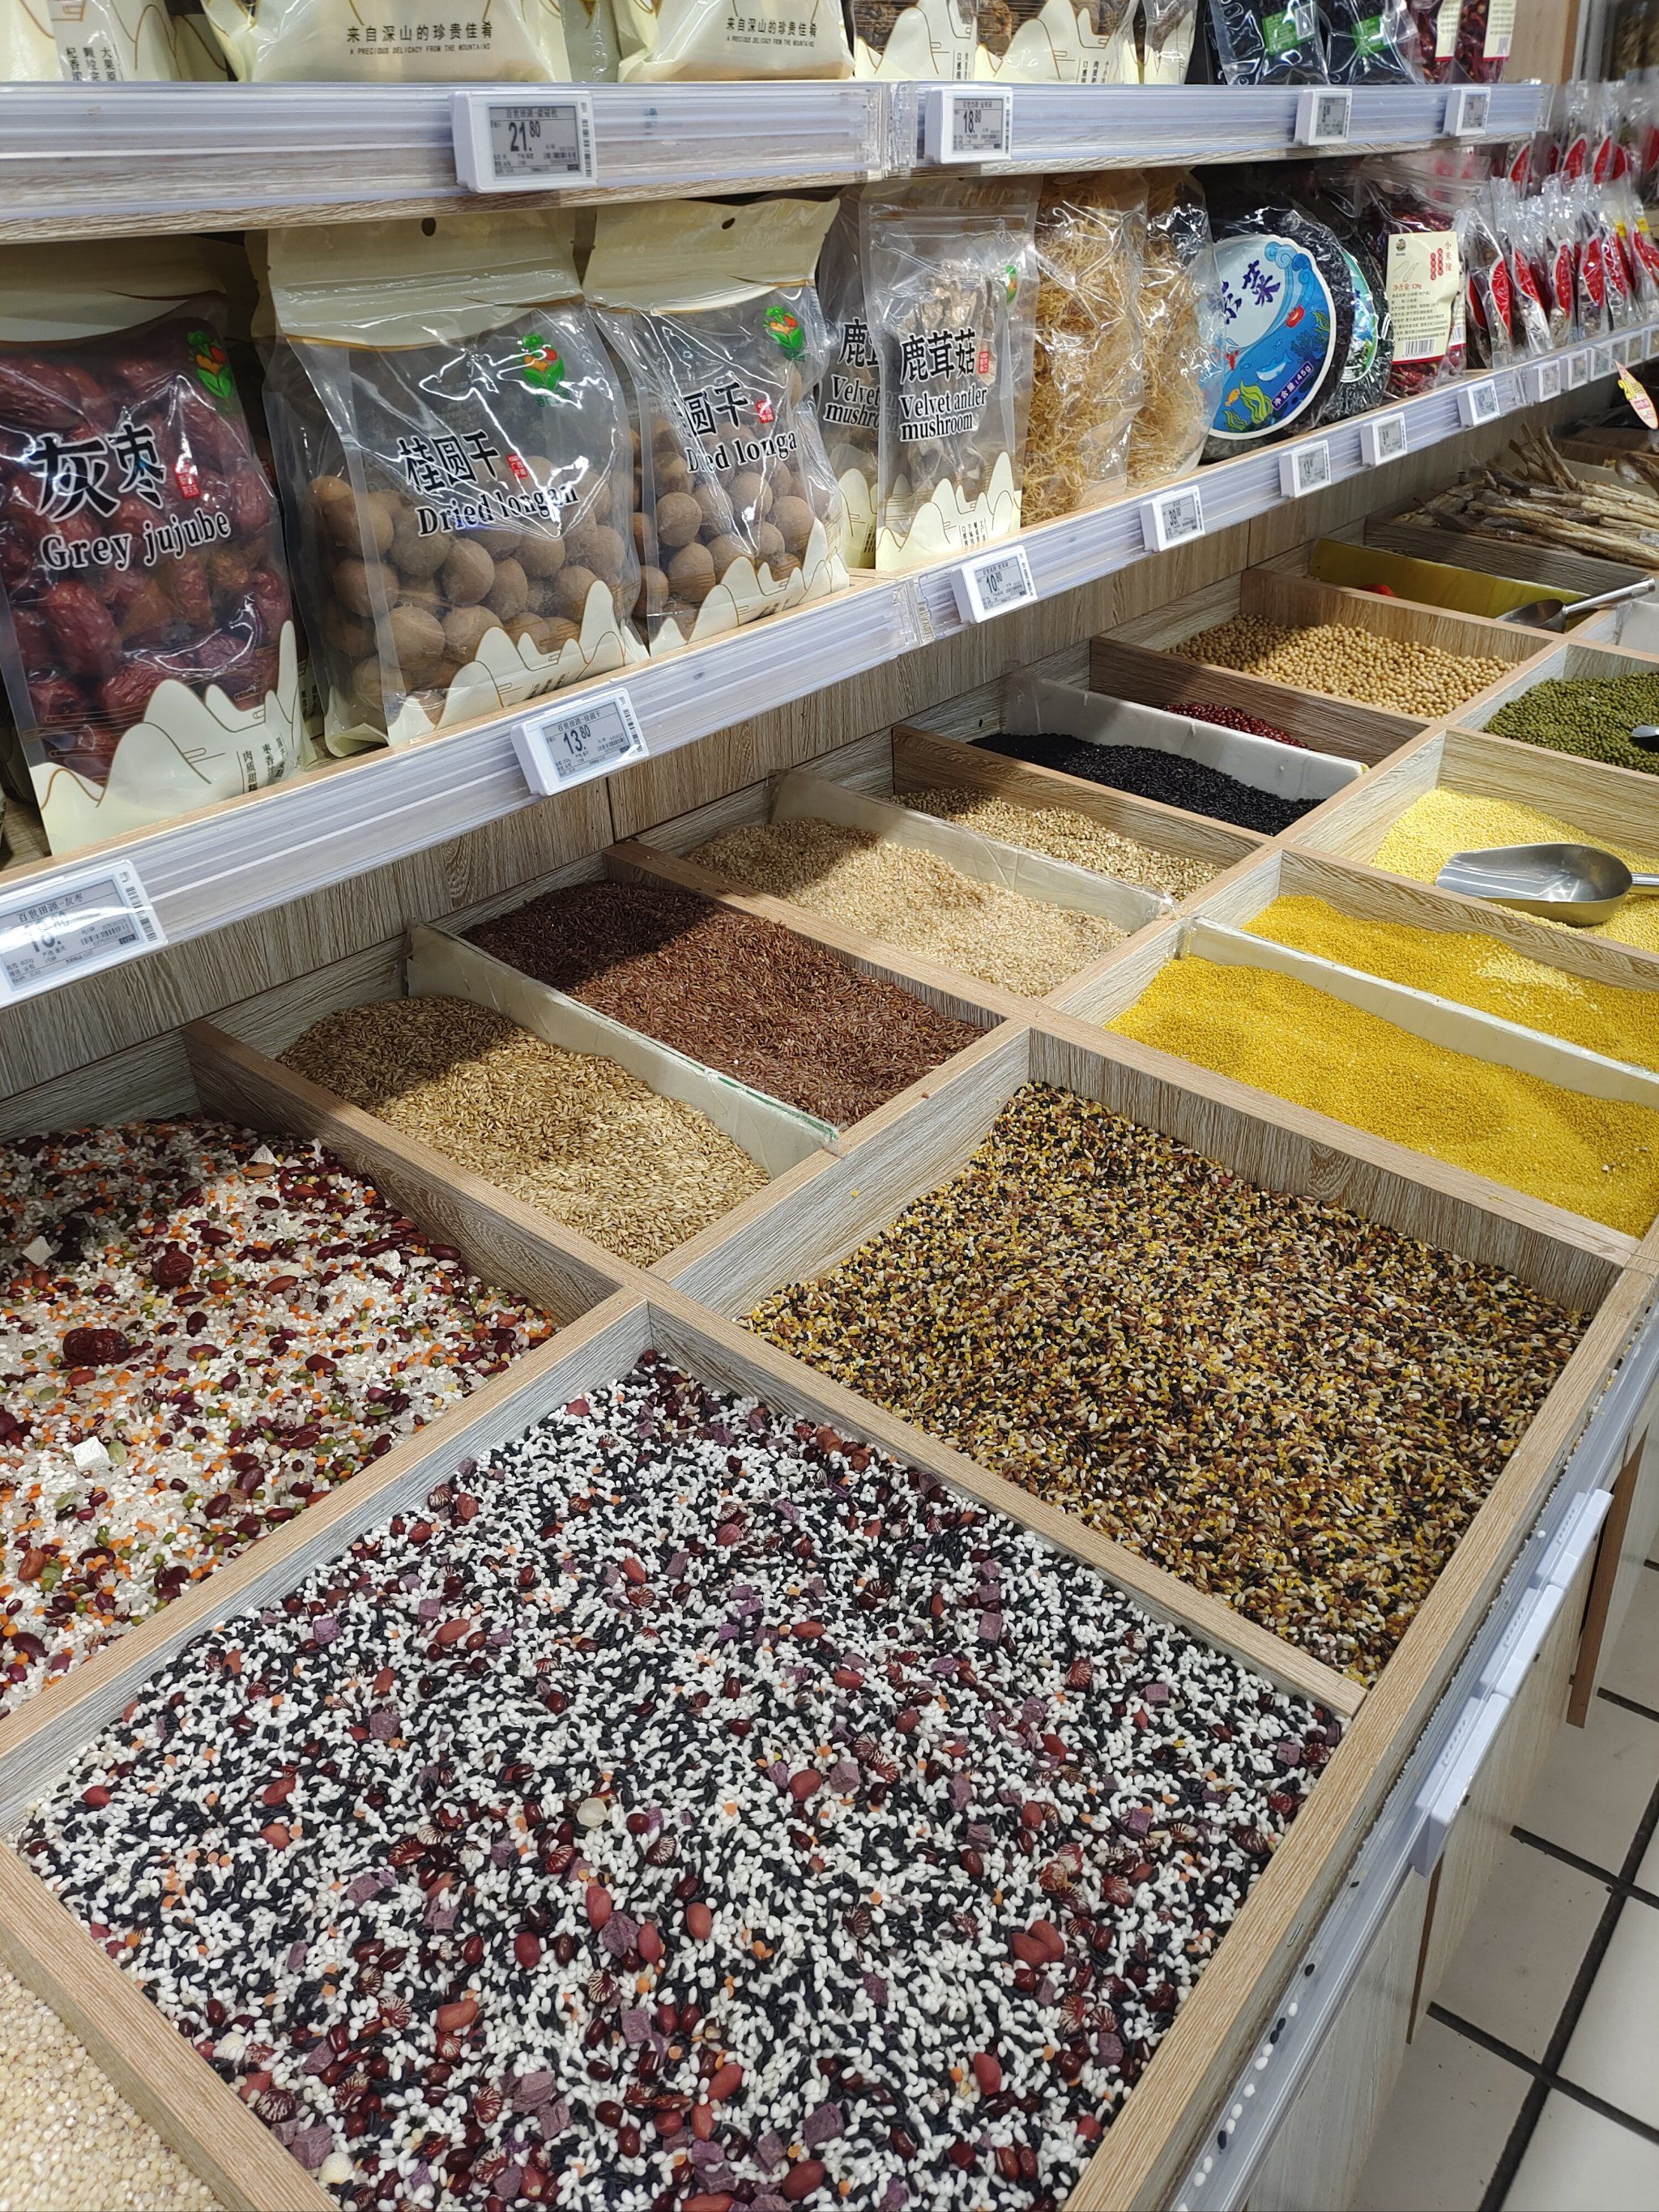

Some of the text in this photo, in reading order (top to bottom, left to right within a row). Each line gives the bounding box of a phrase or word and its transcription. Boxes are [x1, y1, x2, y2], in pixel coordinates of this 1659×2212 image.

[347, 21, 493, 43] 来自深山的珍贵佳肴
[726, 16, 817, 37] 来自深山的珍贵佳肴
[358, 47, 390, 55] PRECIOUS
[393, 46, 422, 54] DELICACY
[445, 44, 455, 52] THE
[458, 42, 491, 51] MOUNTAINS
[899, 328, 976, 385] 鹿茸菇
[898, 390, 951, 420] Velvet
[953, 382, 988, 413] antler
[899, 413, 975, 442] mushroom
[23, 421, 167, 523] 灰枣
[396, 428, 500, 496] 桂圆干
[416, 493, 494, 537] Dried
[41, 507, 232, 572] Grey jujube
